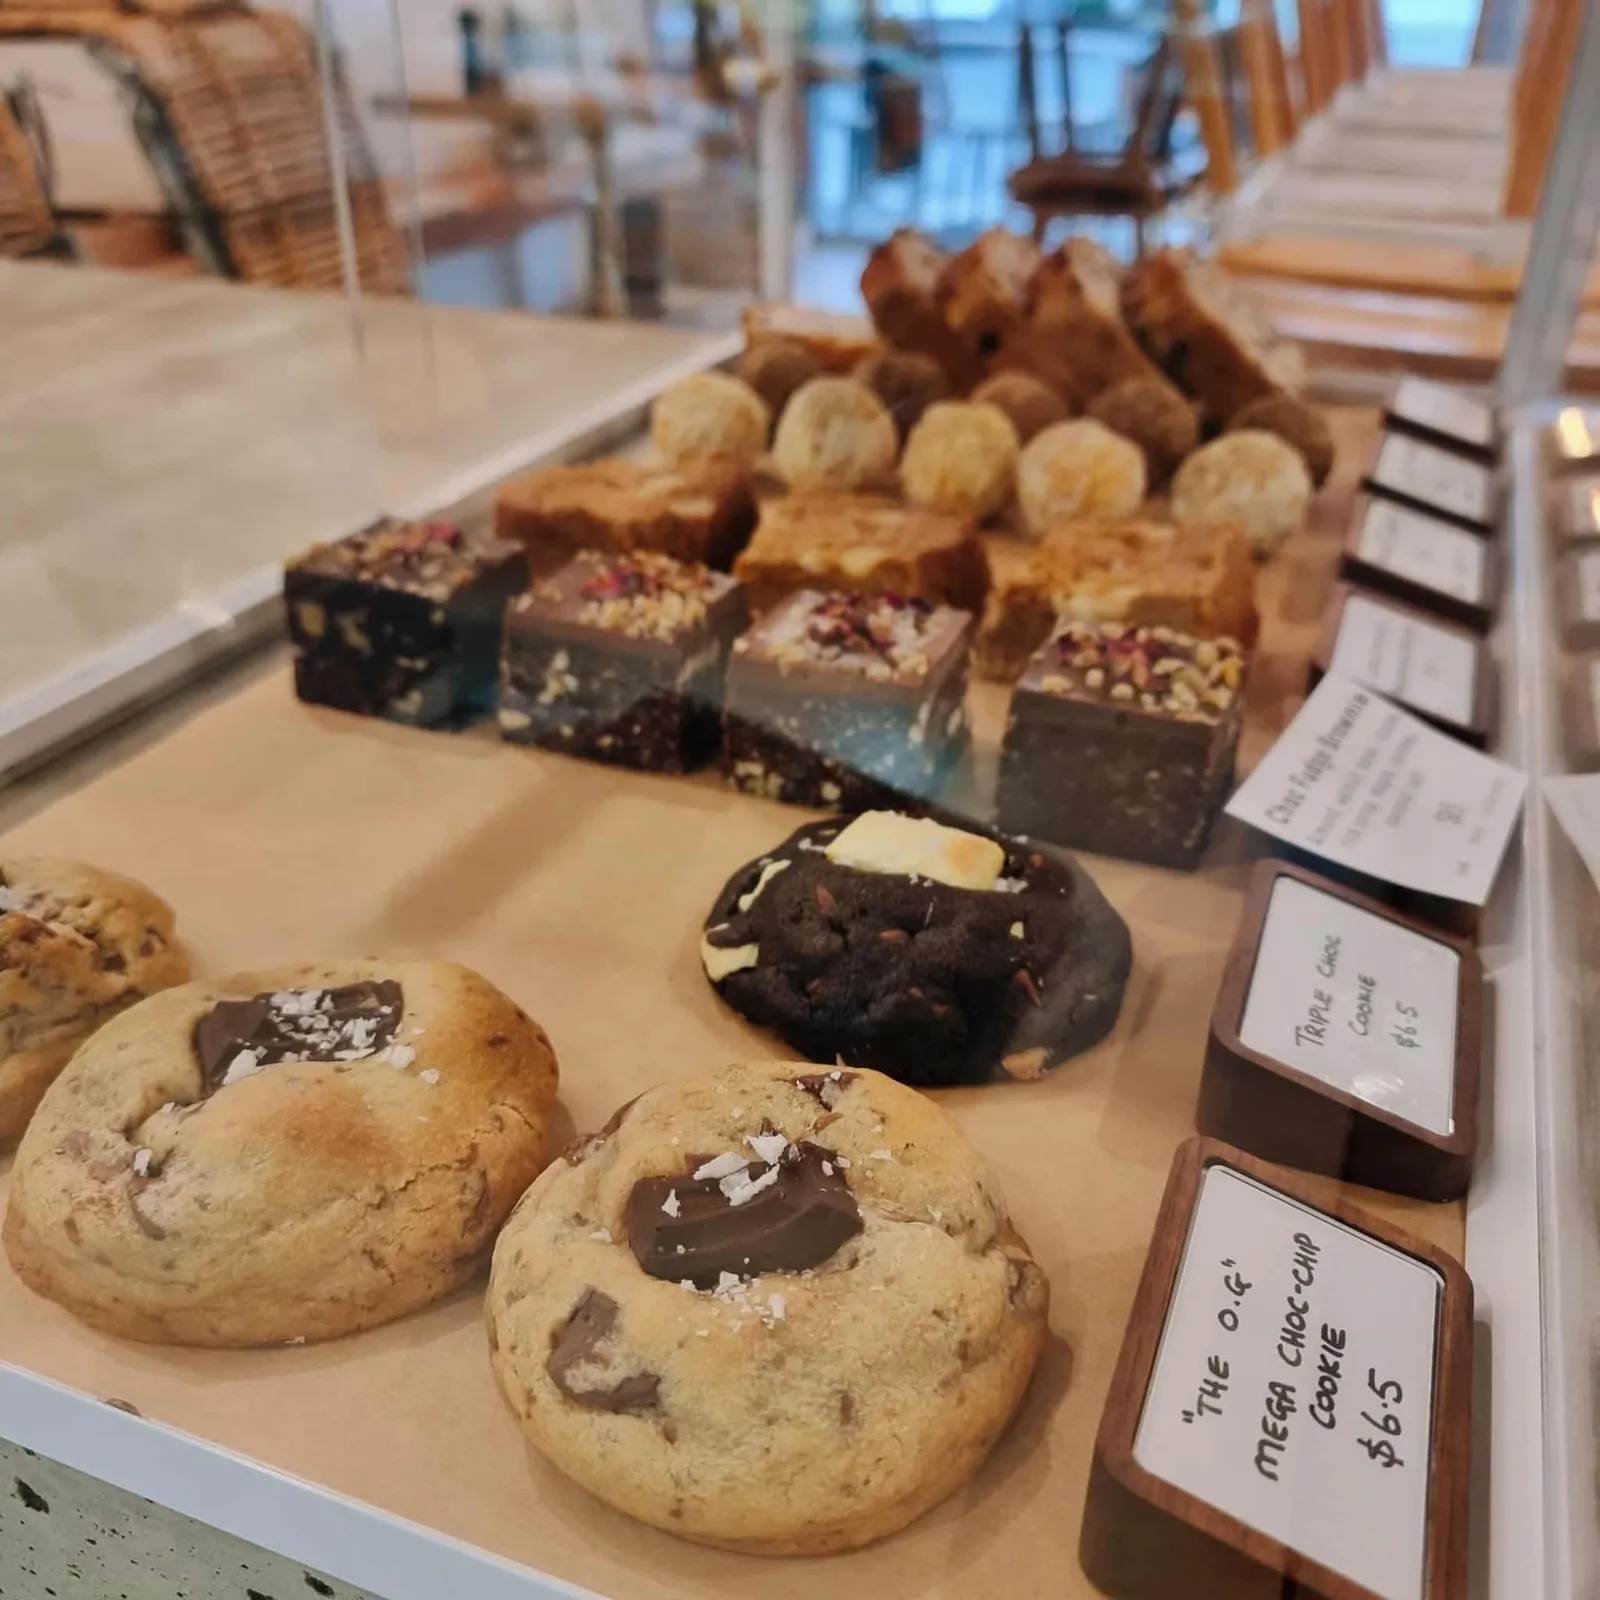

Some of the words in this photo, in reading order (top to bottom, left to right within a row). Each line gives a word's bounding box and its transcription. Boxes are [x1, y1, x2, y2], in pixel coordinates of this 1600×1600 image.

[1295, 988, 1333, 1047] TRIPLE
[1316, 935, 1342, 978] CHOC
[1348, 974, 1377, 1036] COOKIE
[1389, 1001, 1421, 1049] $6.5
[1181, 1354, 1230, 1424] "THE
[1218, 1257, 1253, 1333] O.G"
[1253, 1380, 1296, 1482] MEGA
[1277, 1232, 1322, 1367] CHOC-CHIP
[1309, 1322, 1347, 1430] COOKIE
[1356, 1367, 1404, 1469] $6.5
